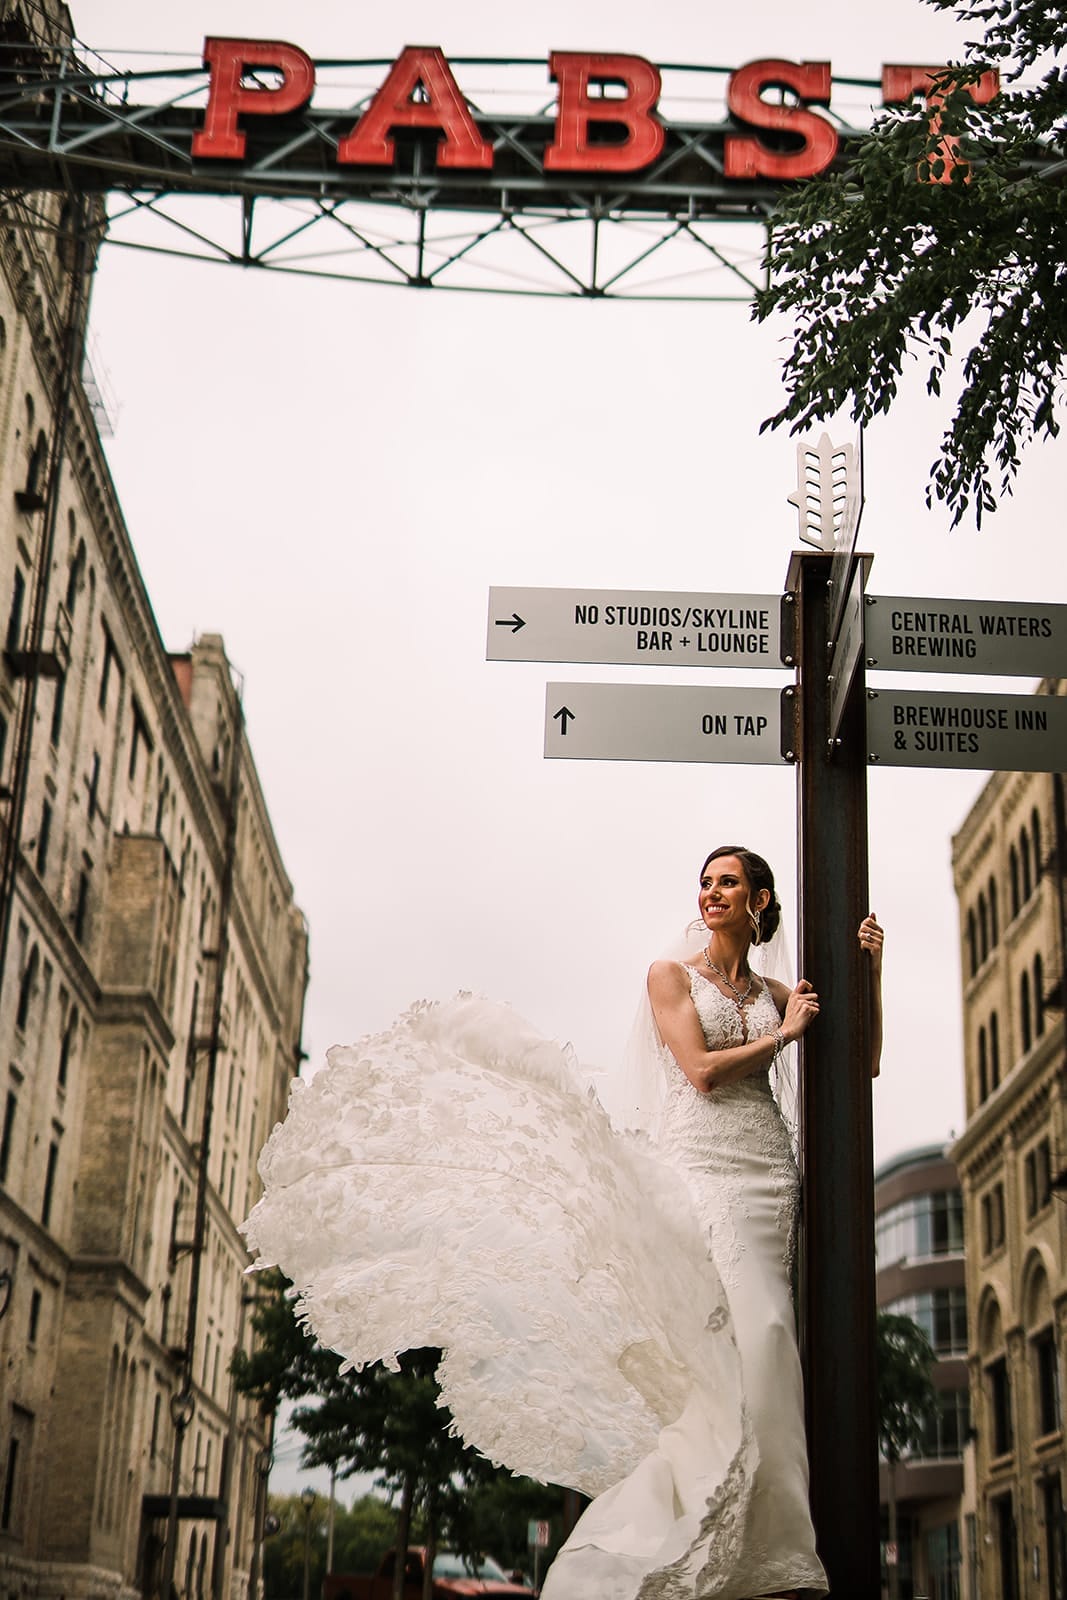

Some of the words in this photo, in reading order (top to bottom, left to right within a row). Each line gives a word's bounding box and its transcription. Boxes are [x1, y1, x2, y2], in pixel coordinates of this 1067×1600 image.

[575, 605, 599, 625] NO
[604, 605, 769, 630] STUDIOS/SKYLINE
[891, 611, 974, 635] CENTRAL
[979, 615, 1052, 638] WATERS
[637, 630, 673, 651] BAR
[697, 632, 769, 654] LOUNGE
[892, 635, 977, 659] BREWING
[702, 714, 727, 735] ON
[733, 715, 768, 736] TAP
[893, 705, 1009, 730] BREWHOUSE
[1015, 710, 1047, 731] INN
[894, 729, 908, 751] &
[914, 730, 980, 753] SUITES
